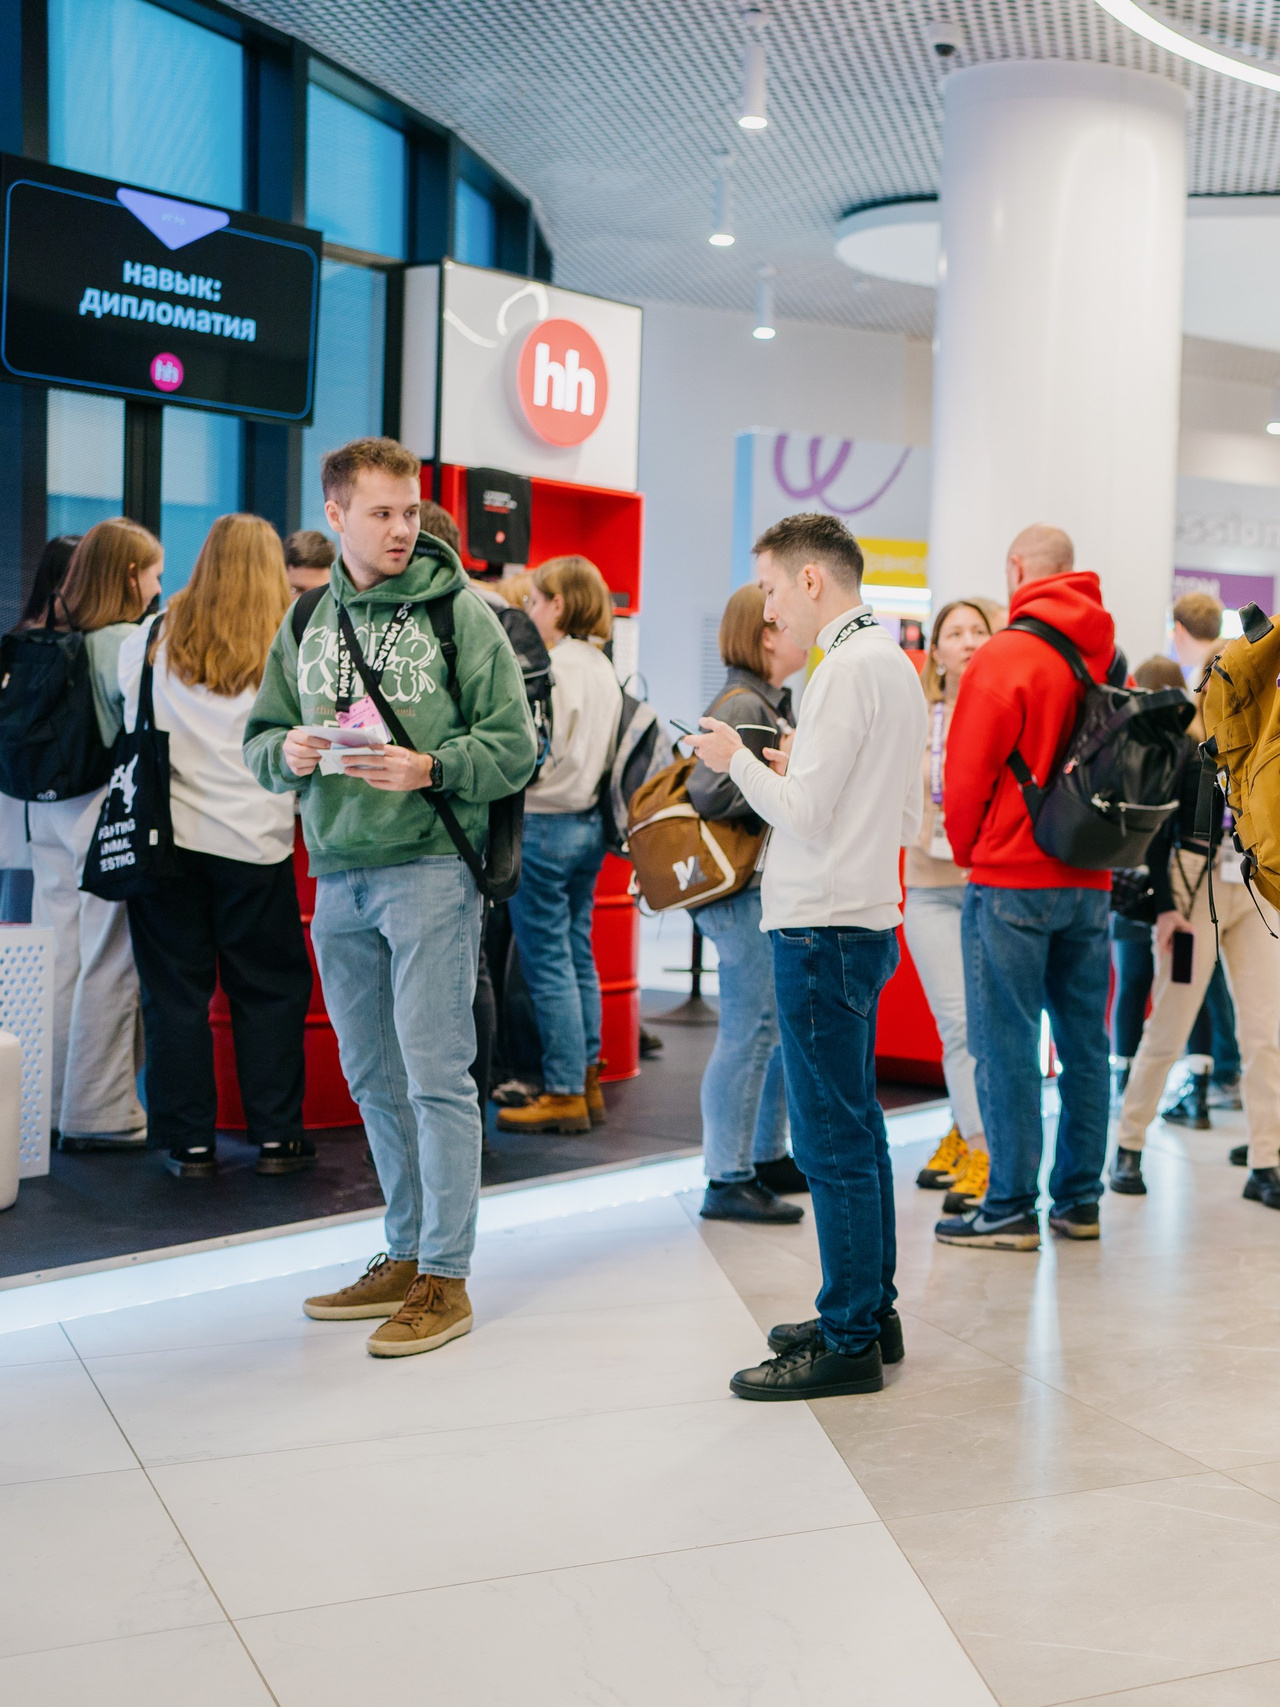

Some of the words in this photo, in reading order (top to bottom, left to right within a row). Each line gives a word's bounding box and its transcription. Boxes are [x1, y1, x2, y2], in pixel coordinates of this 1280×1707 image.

[122, 259, 223, 303] навык:
[78, 286, 257, 343] дипломатия
[154, 358, 180, 385] hh
[533, 341, 596, 417] hh
